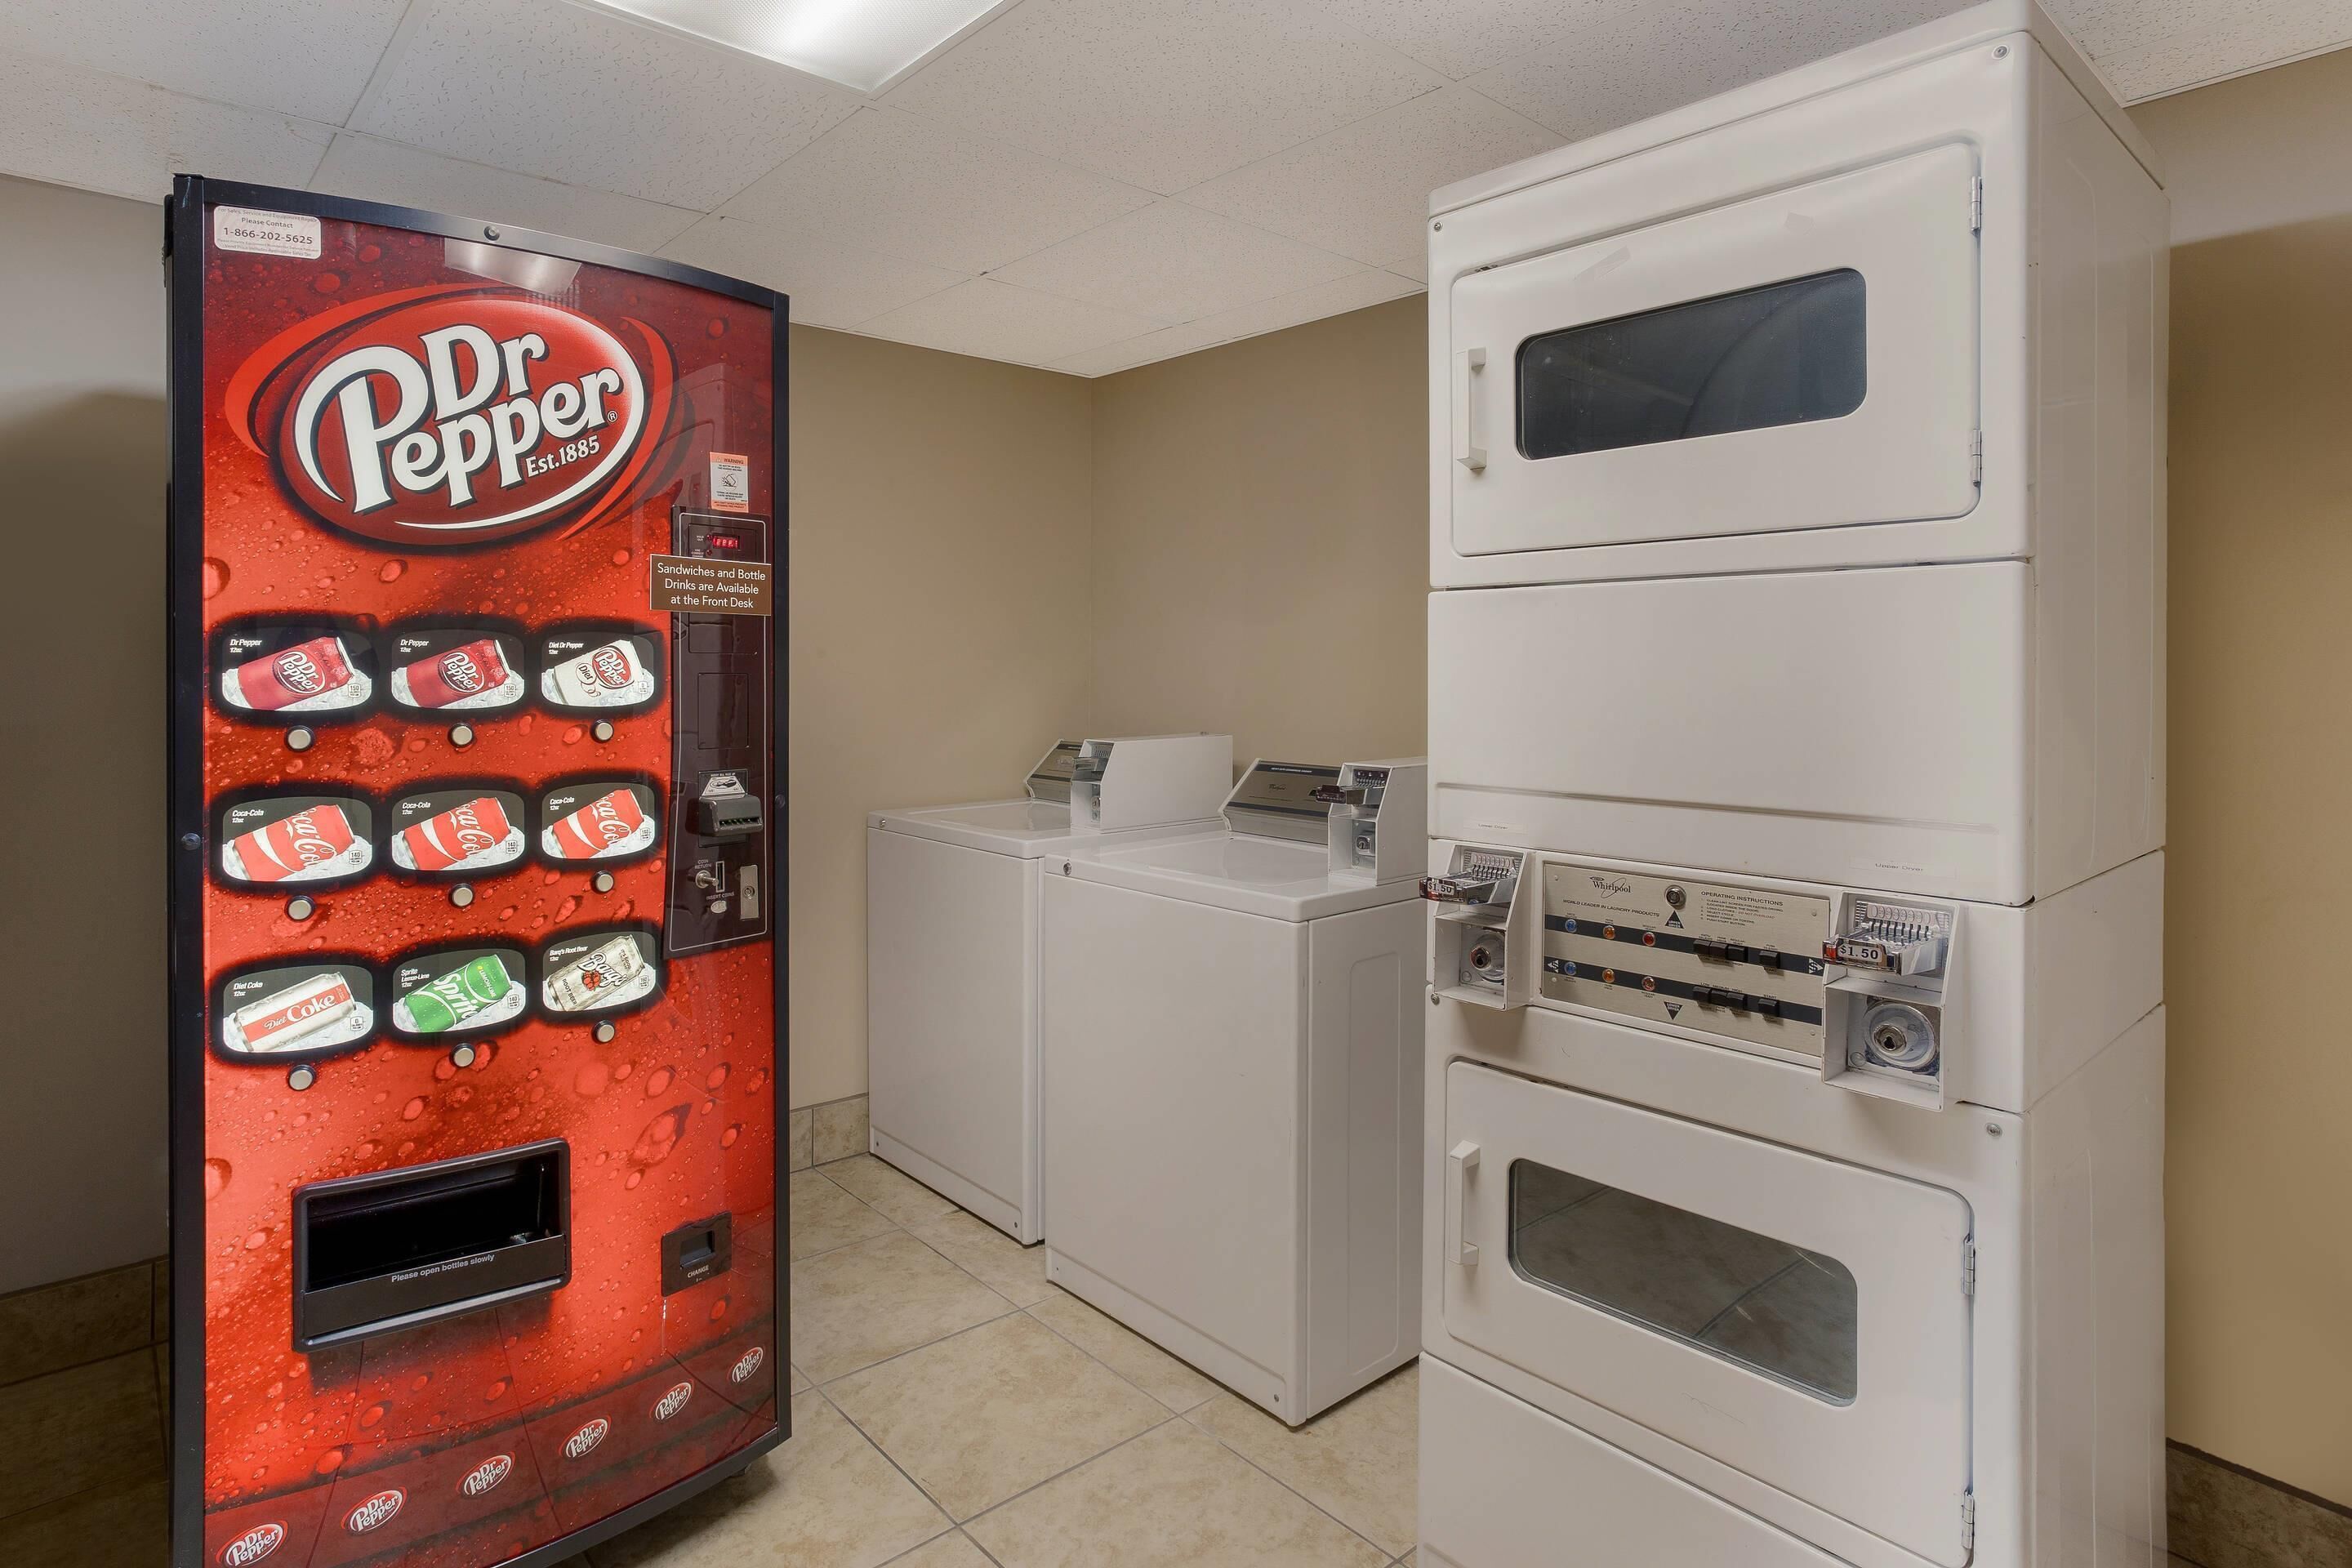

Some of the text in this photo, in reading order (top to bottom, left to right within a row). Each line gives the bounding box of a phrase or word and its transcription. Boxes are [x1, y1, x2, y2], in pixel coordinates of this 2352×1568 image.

[242, 217, 293, 229] Please Contact
[224, 228, 313, 244] 1-866-202-5625
[420, 324, 548, 421] Dr
[295, 345, 621, 513] Pepper
[657, 563, 766, 581] Sandwiches and Bottle
[665, 578, 759, 595] Drinks are Available
[670, 595, 754, 608] at the Front Desk
[239, 639, 262, 648] Pepper
[278, 651, 318, 691] Pepper
[298, 660, 319, 679] Dr
[443, 652, 479, 691] Pepper
[461, 662, 479, 679] Dr
[579, 666, 594, 680] Diet
[595, 652, 626, 685] Pepper
[612, 659, 626, 675] Dr
[550, 797, 575, 805] Coca-Cola
[1428, 883, 1452, 893] $1.50
[1592, 881, 1631, 893] Whirlpool
[1701, 891, 1784, 906] OPERATING INSTRUCTIONS
[1632, 909, 1659, 917] PRODUCTS
[1840, 944, 1878, 960] $1.50
[401, 969, 418, 977] Sprite
[401, 973, 430, 982] Lemon-Lime
[577, 952, 628, 988] Barq's
[568, 991, 577, 1005] BEER
[264, 1015, 287, 1030] Diet
[287, 994, 336, 1022] Coke
[392, 1254, 495, 1283] Please open bottles slowly
[688, 1265, 710, 1278] CHANGE
[733, 1352, 760, 1383] Pepper
[742, 1352, 753, 1366] Dr
[656, 1387, 688, 1420] Pepper
[667, 1388, 679, 1403] Dr
[566, 1423, 604, 1458] Pepper
[580, 1424, 595, 1441] Dr
[464, 1460, 507, 1495] Pepper
[479, 1461, 497, 1478] Dr
[350, 1495, 398, 1532] Pepper
[368, 1496, 386, 1514] Dr
[226, 1529, 278, 1566] Pepper
[244, 1530, 265, 1548] Dr
